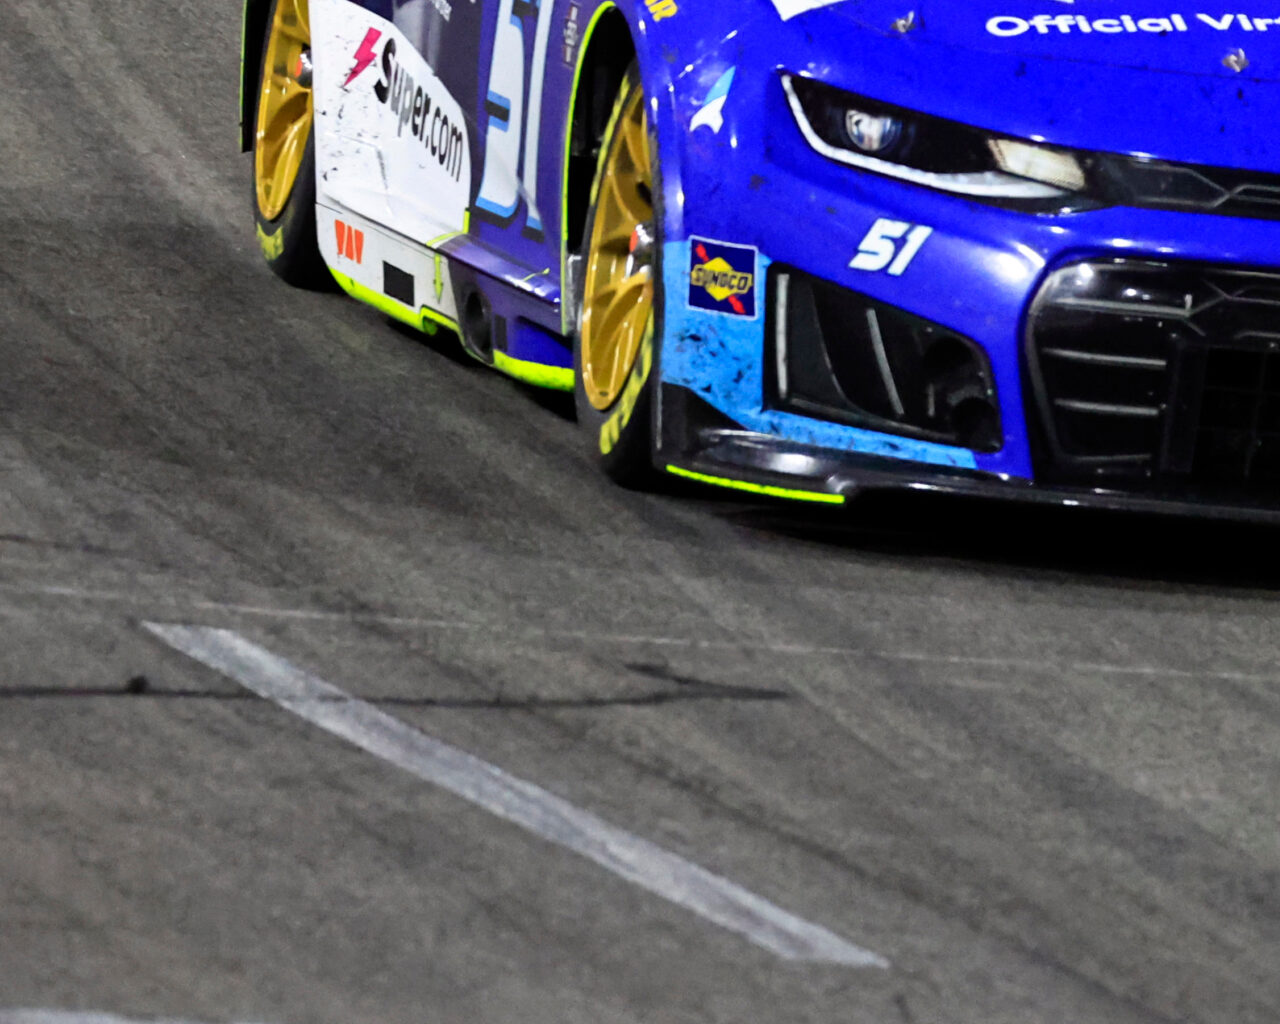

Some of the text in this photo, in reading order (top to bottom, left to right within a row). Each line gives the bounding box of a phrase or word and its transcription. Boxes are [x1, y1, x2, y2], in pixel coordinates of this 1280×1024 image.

[985, 14, 1188, 37] Official
[373, 37, 464, 183] Super.com
[848, 217, 934, 277] 51
[692, 265, 750, 292] SUNOCO
